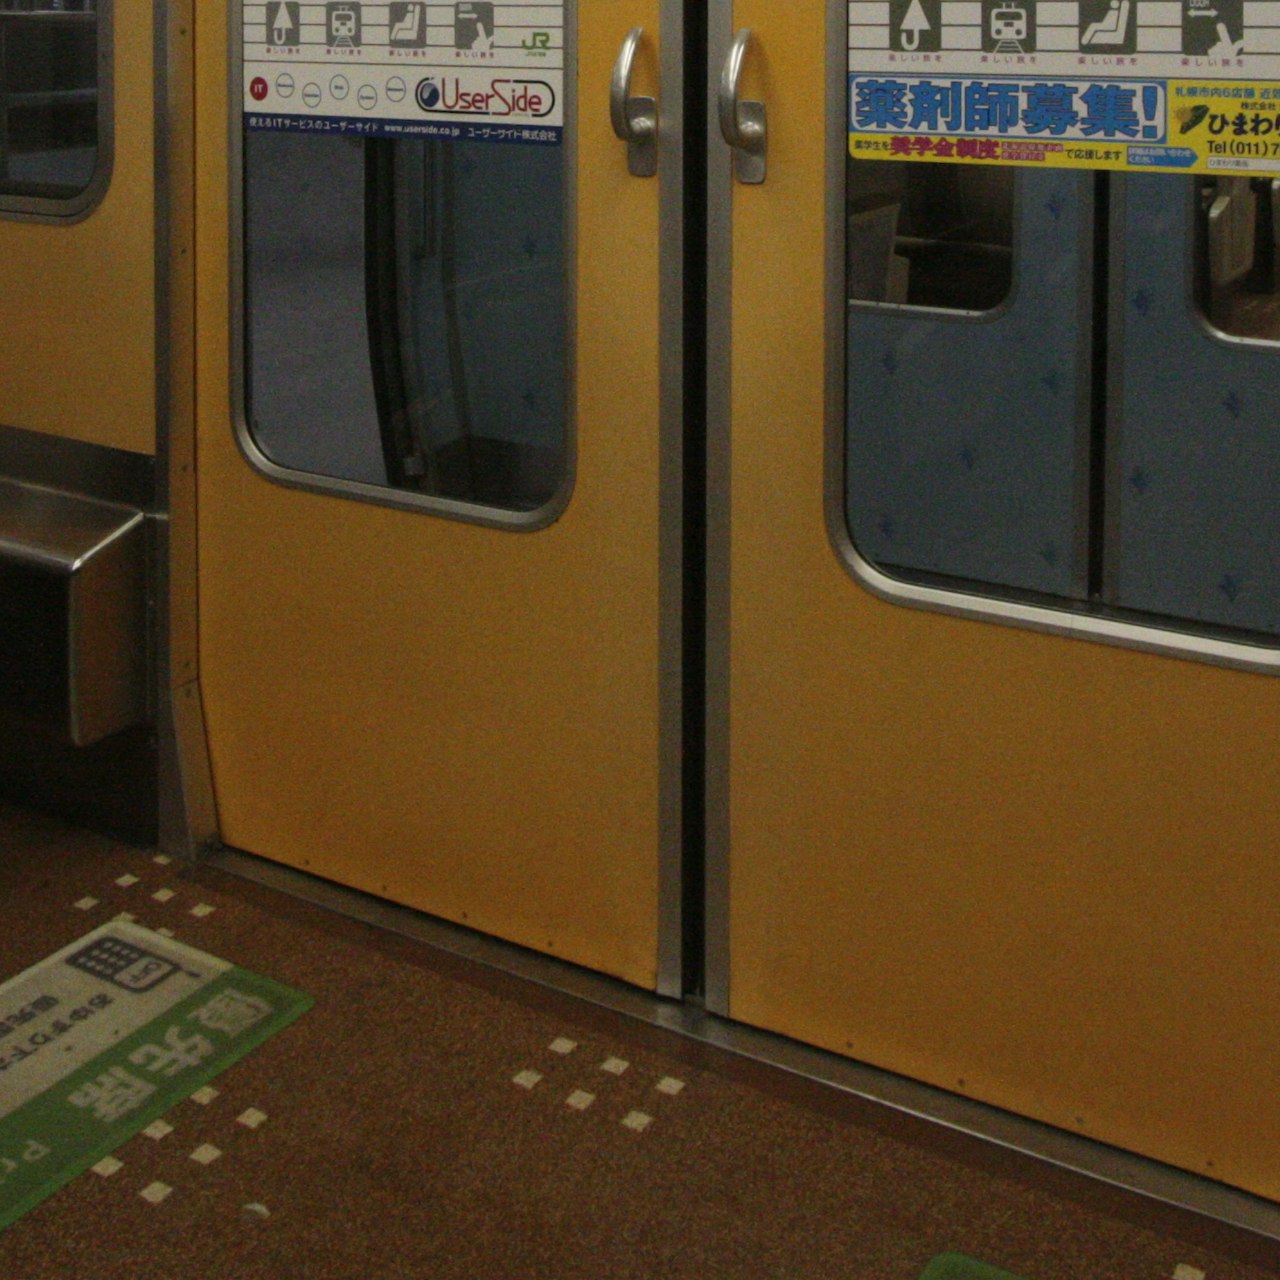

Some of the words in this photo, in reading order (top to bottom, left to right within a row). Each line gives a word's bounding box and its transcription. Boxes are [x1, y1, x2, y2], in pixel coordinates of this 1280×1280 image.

[521, 32, 550, 50] JR
[254, 84, 263, 94] IT
[441, 77, 542, 116] UserSide
[384, 124, 460, 136] www.userside.co.jp
[68, 988, 275, 1120] 優先席
